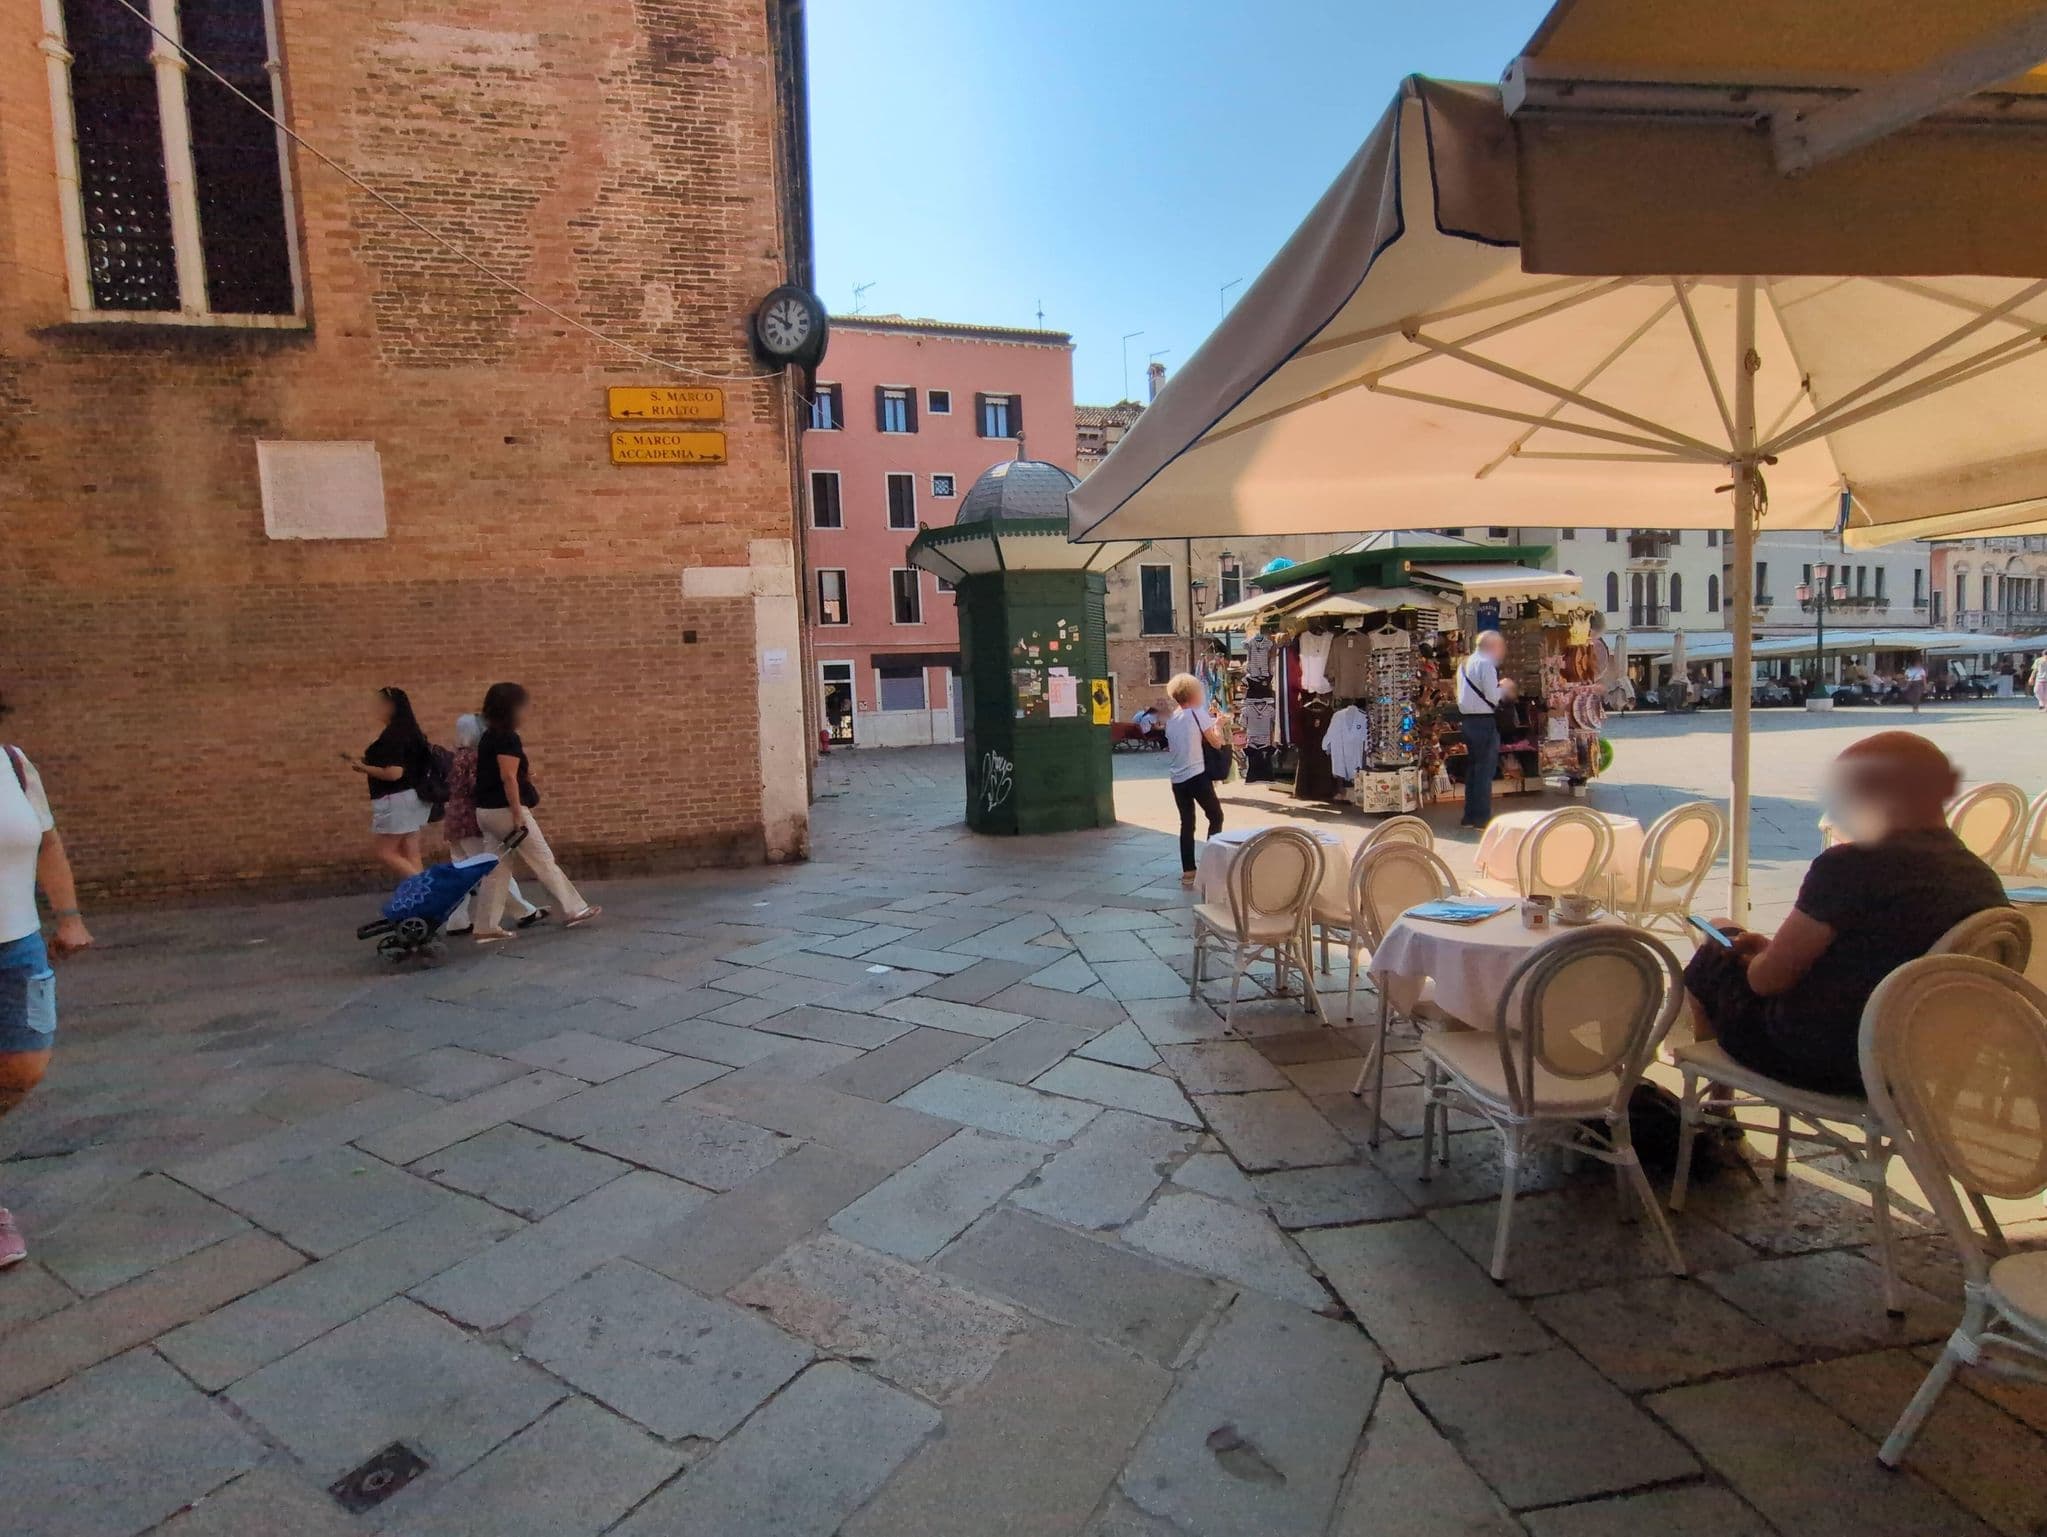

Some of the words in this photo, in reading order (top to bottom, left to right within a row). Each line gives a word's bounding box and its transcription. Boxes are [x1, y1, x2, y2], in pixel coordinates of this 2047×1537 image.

[650, 392, 661, 402] S.
[667, 392, 714, 402] MARCO
[652, 406, 699, 415] RIALTO
[616, 436, 627, 446] S.
[633, 436, 681, 445] MARCO
[619, 449, 694, 459] ACCADEMIA
